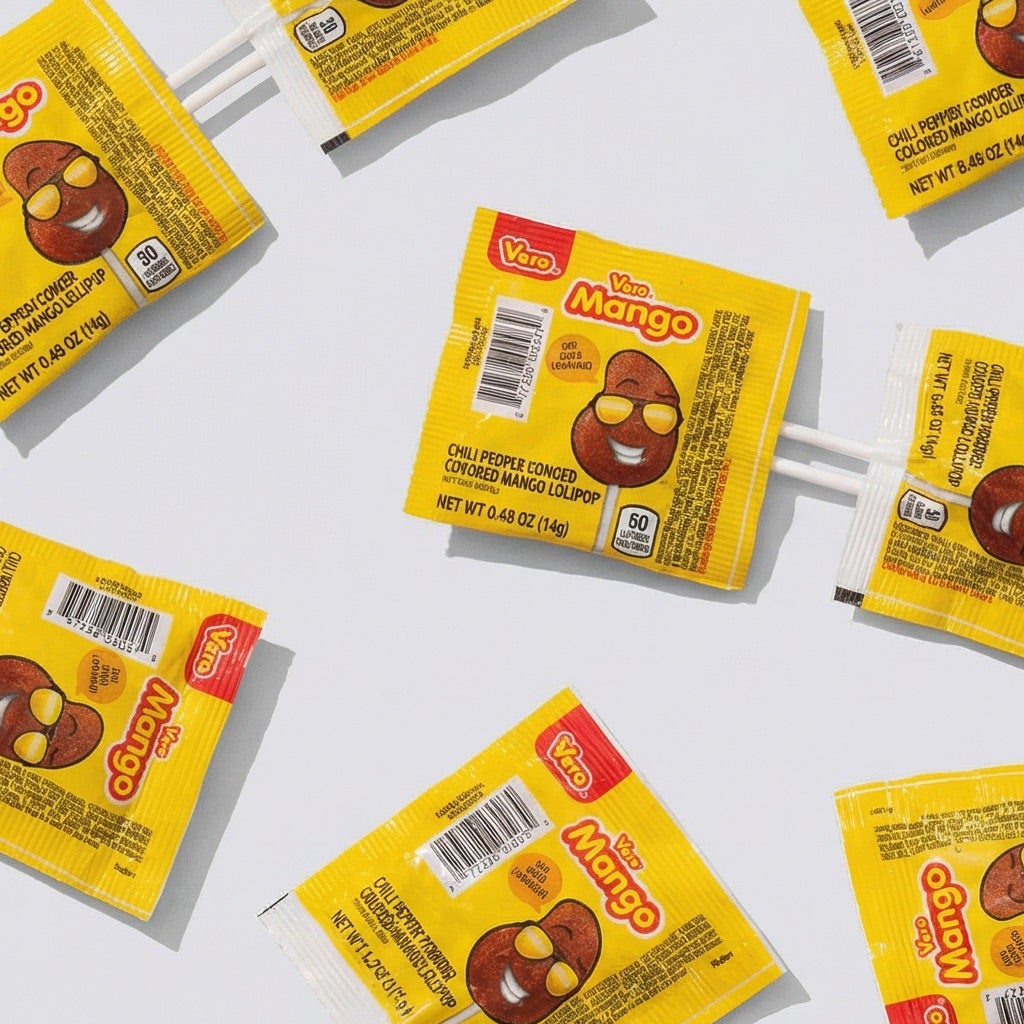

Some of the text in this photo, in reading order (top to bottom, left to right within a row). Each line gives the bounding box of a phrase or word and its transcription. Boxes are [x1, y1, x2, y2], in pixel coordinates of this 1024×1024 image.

[947, 108, 994, 140] MANGO
[908, 172, 935, 197] NET
[933, 163, 956, 185] WT
[984, 141, 1005, 162] OZ
[21, 300, 65, 338] MANGO
[566, 283, 697, 340] Mango
[16, 361, 41, 384] WT
[62, 329, 84, 351] OZ
[447, 442, 479, 463] CHILI
[499, 469, 547, 495] MANGO
[547, 481, 602, 506] LOLIPOP
[435, 493, 570, 540] NET WT 0.48 OZ (14g)
[627, 512, 650, 533] 60
[109, 679, 175, 799] Mango
[552, 734, 587, 787] Vero
[563, 821, 658, 932] Mango
[330, 908, 355, 934] NET
[923, 865, 976, 982] Mango
